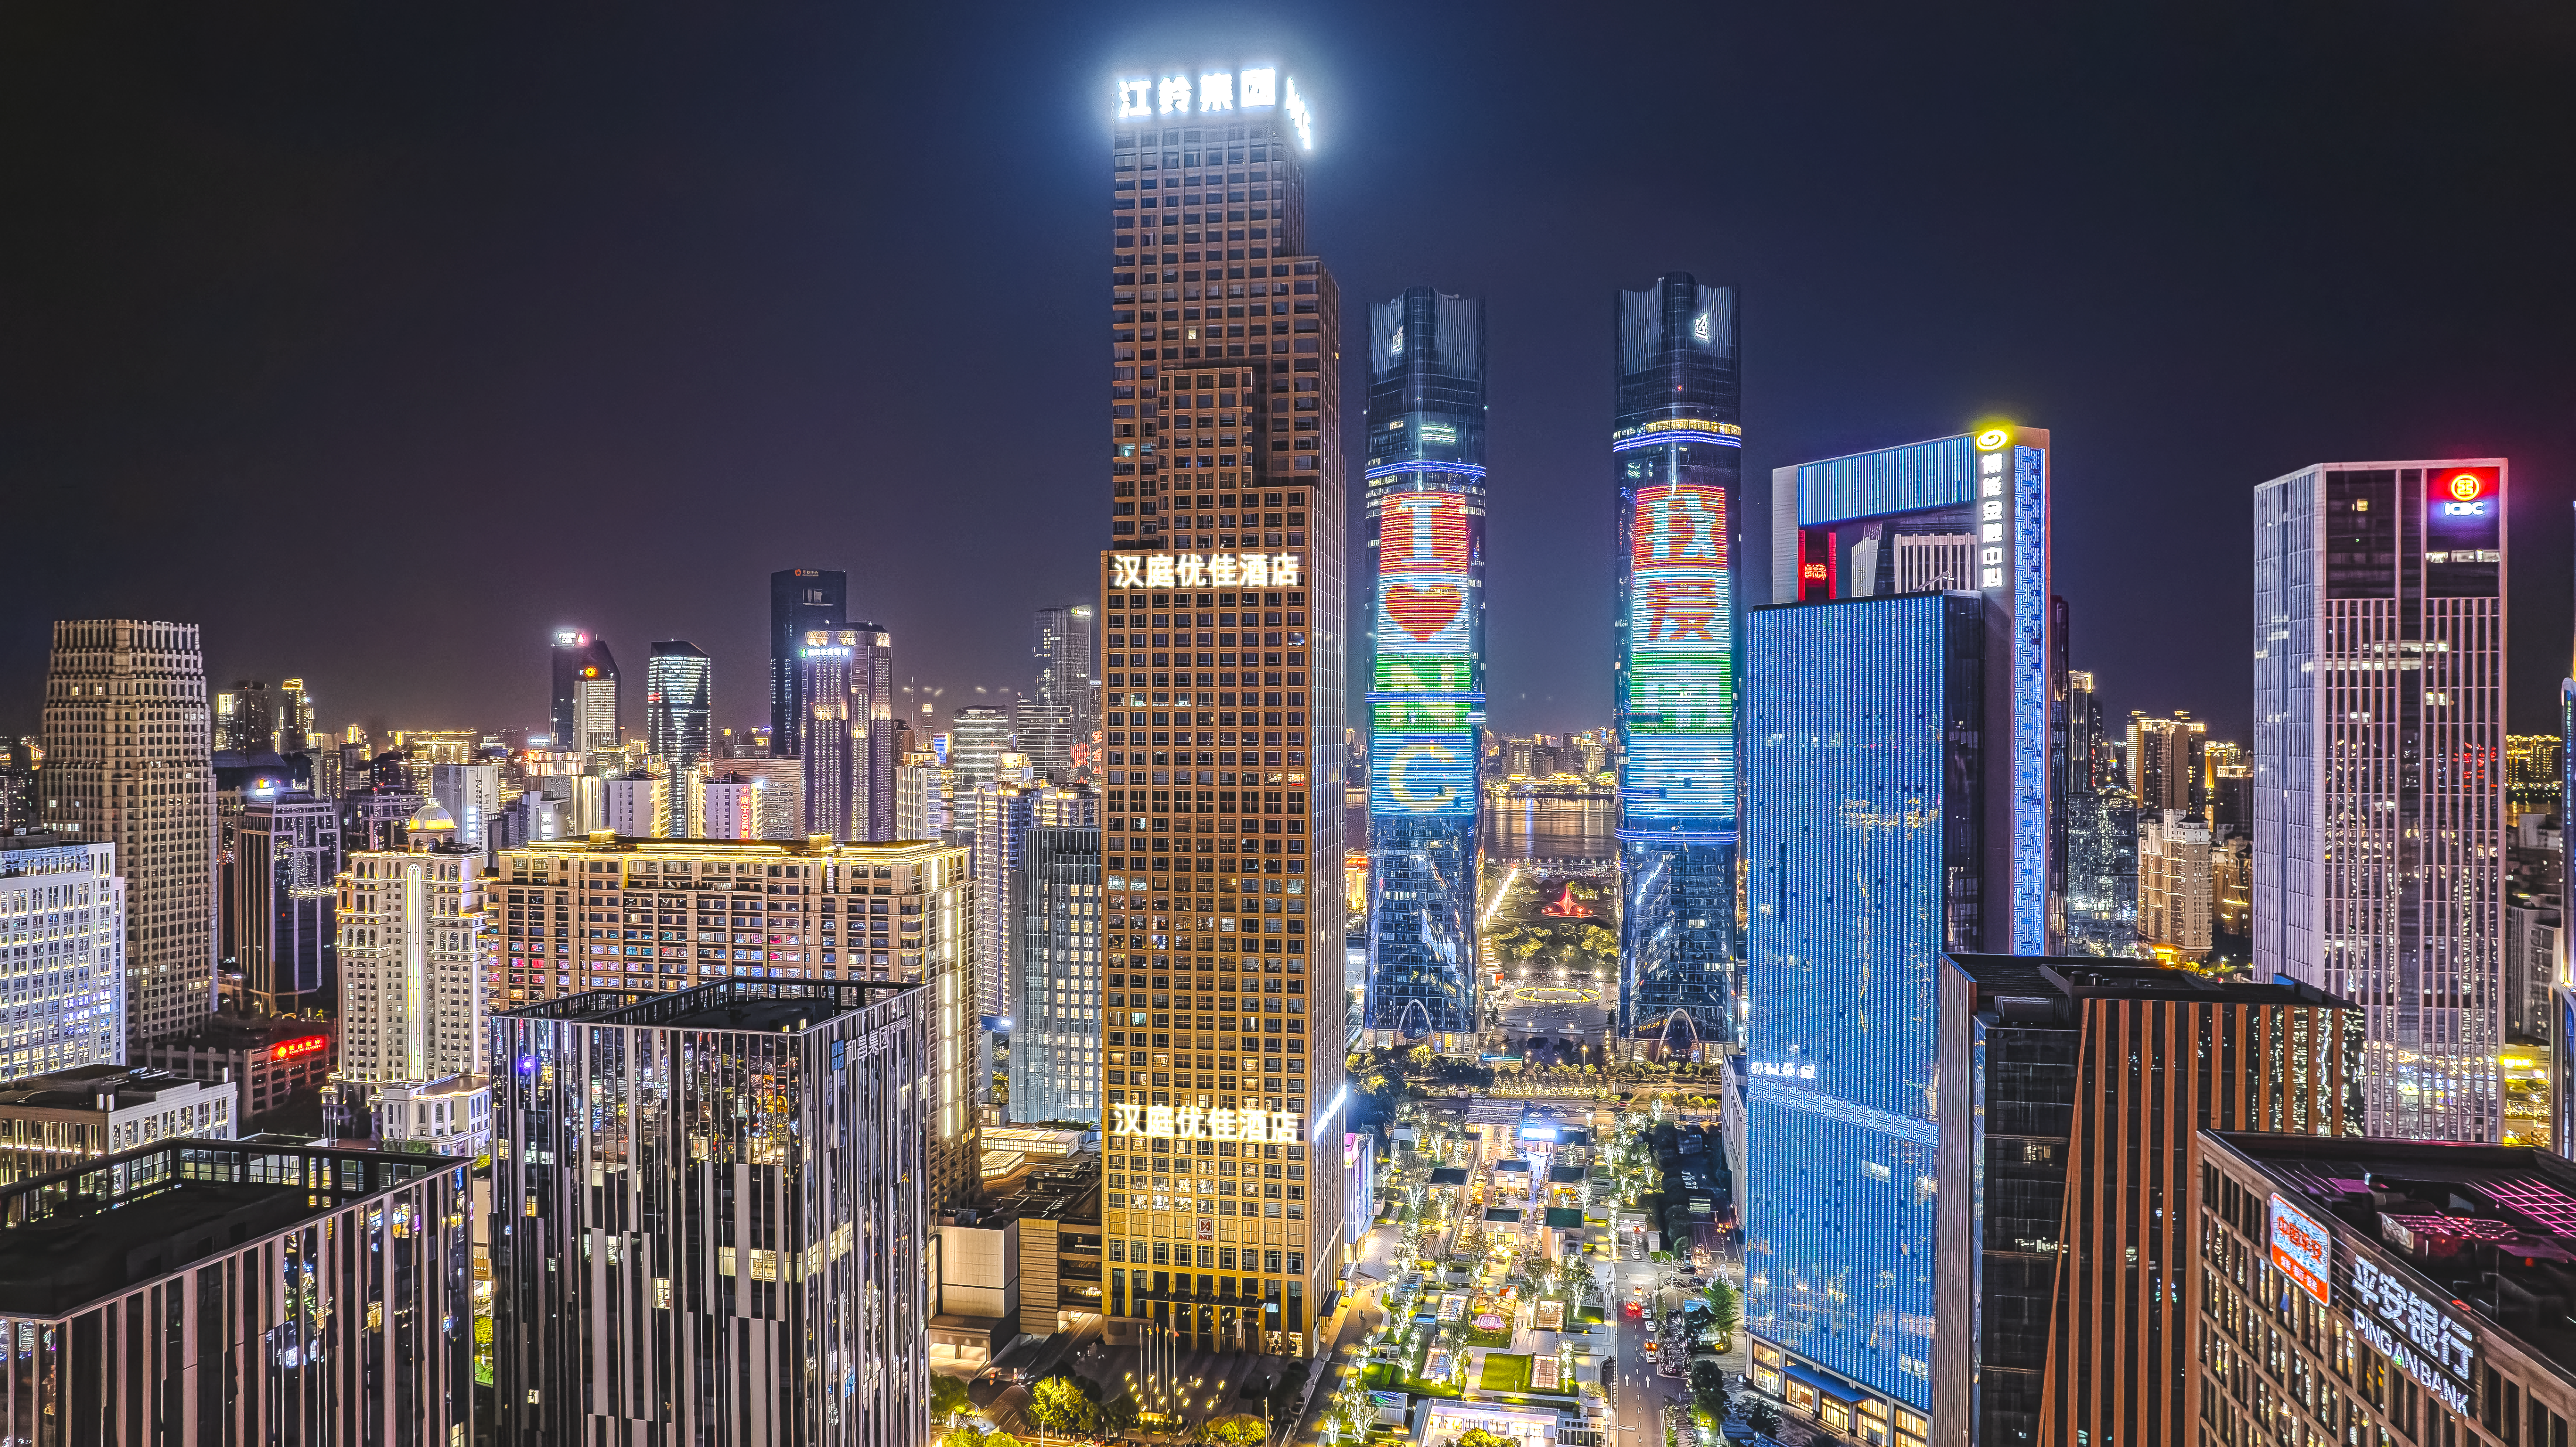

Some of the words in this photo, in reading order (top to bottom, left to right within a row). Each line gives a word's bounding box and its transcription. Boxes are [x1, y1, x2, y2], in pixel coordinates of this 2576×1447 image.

[1118, 68, 1276, 118] 江铃集团
[2444, 502, 2485, 516] ICBC
[1114, 553, 1299, 587] 汉庭优佳酒店
[845, 1025, 890, 1064] 和昌集团
[1113, 1102, 1299, 1143] 汉庭优佳酒店
[2352, 1254, 2474, 1381] 平安银行
